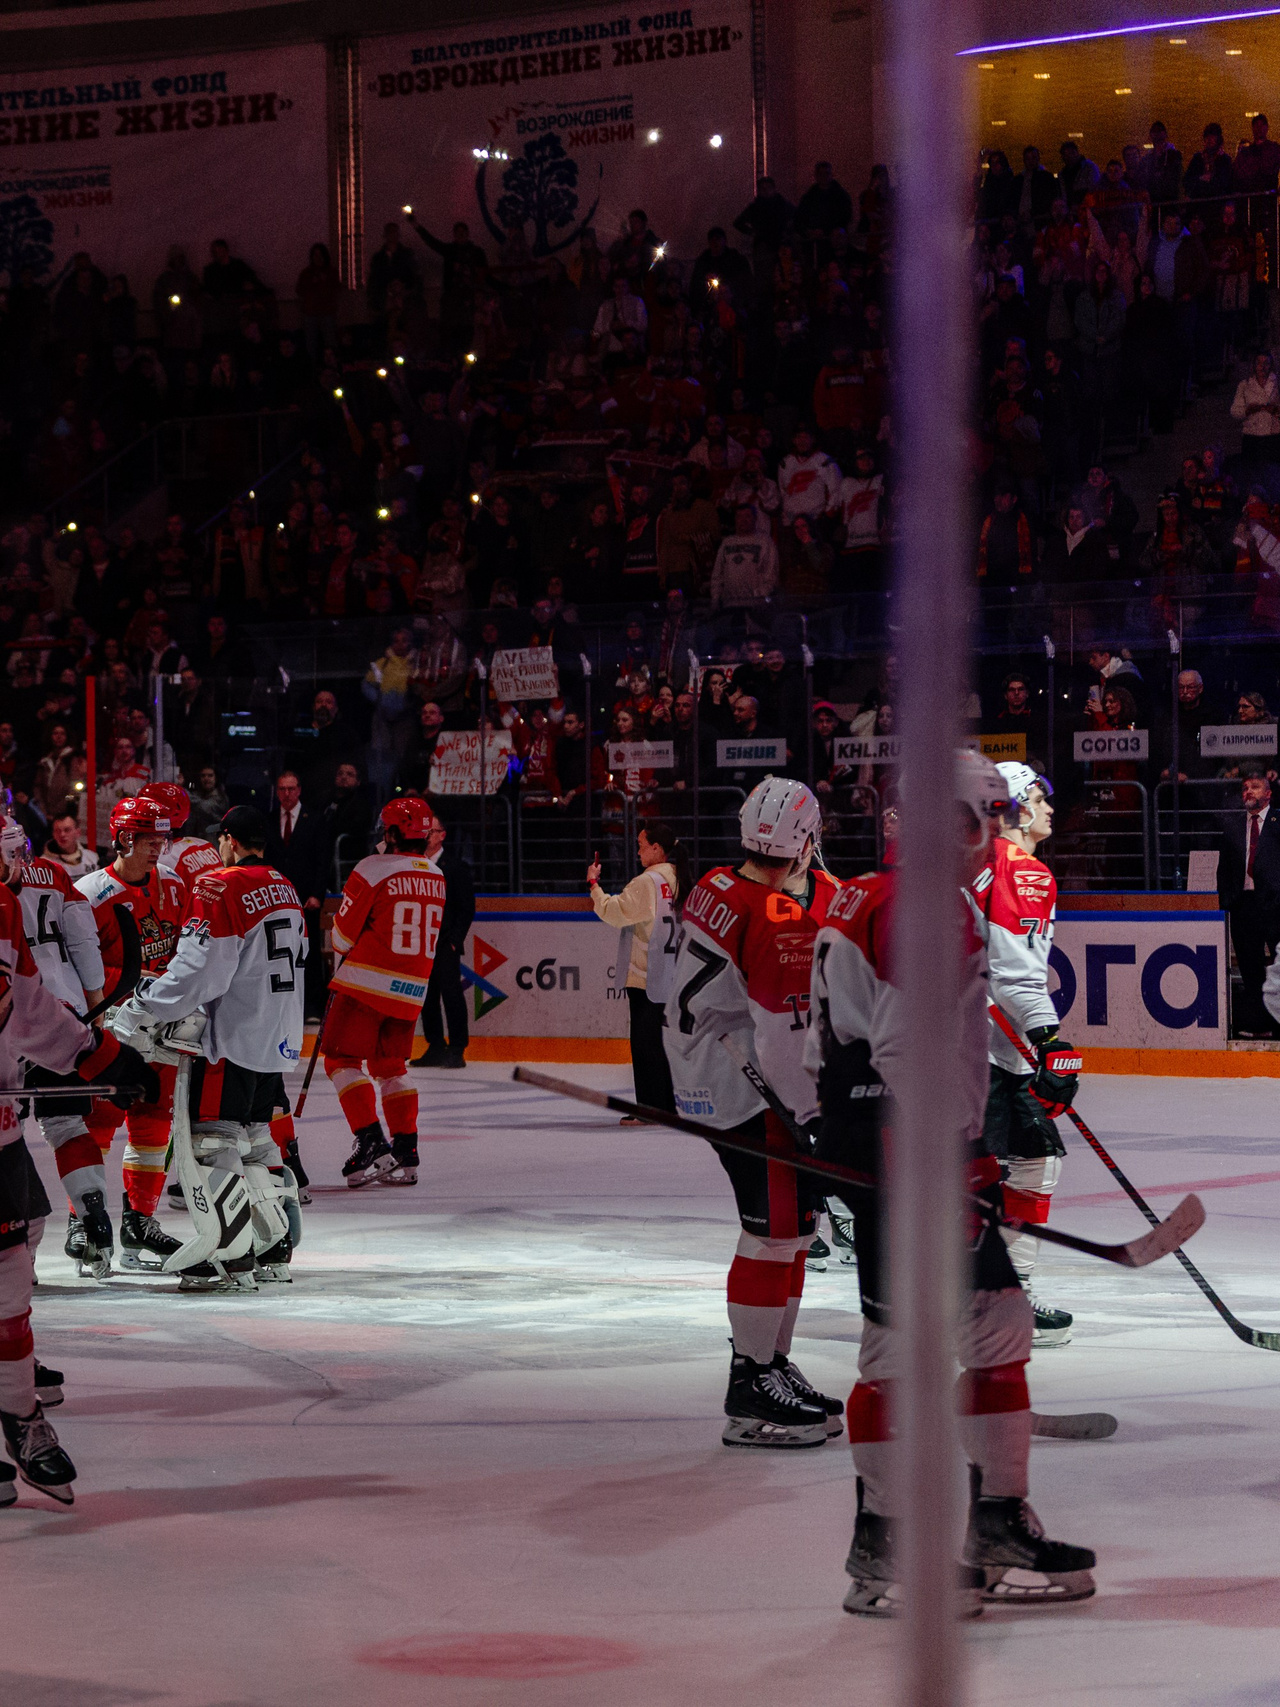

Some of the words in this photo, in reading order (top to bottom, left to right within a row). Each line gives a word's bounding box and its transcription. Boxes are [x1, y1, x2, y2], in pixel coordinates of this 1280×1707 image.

[411, 15, 631, 65] БЛАГОТВОРИТЕЛЬНЫЙ
[638, 9, 693, 33] ФОНД
[612, 25, 743, 67] ЖИЗНИ»
[152, 71, 227, 97] ФОНД
[115, 92, 293, 136] ЖИЗНИ»
[516, 104, 634, 134] ВОЗРОЖДЕНИЕ
[569, 123, 635, 147] ЖИЗНИ
[43, 190, 113, 209] ЖИЗНИ
[726, 745, 777, 760] SIBUR
[984, 742, 1018, 754] БАНК
[20, 867, 54, 885] ANOV
[241, 882, 303, 915] SEREBRYA
[179, 917, 211, 946] 54
[391, 901, 444, 960] 86
[390, 979, 426, 998] SIBUR
